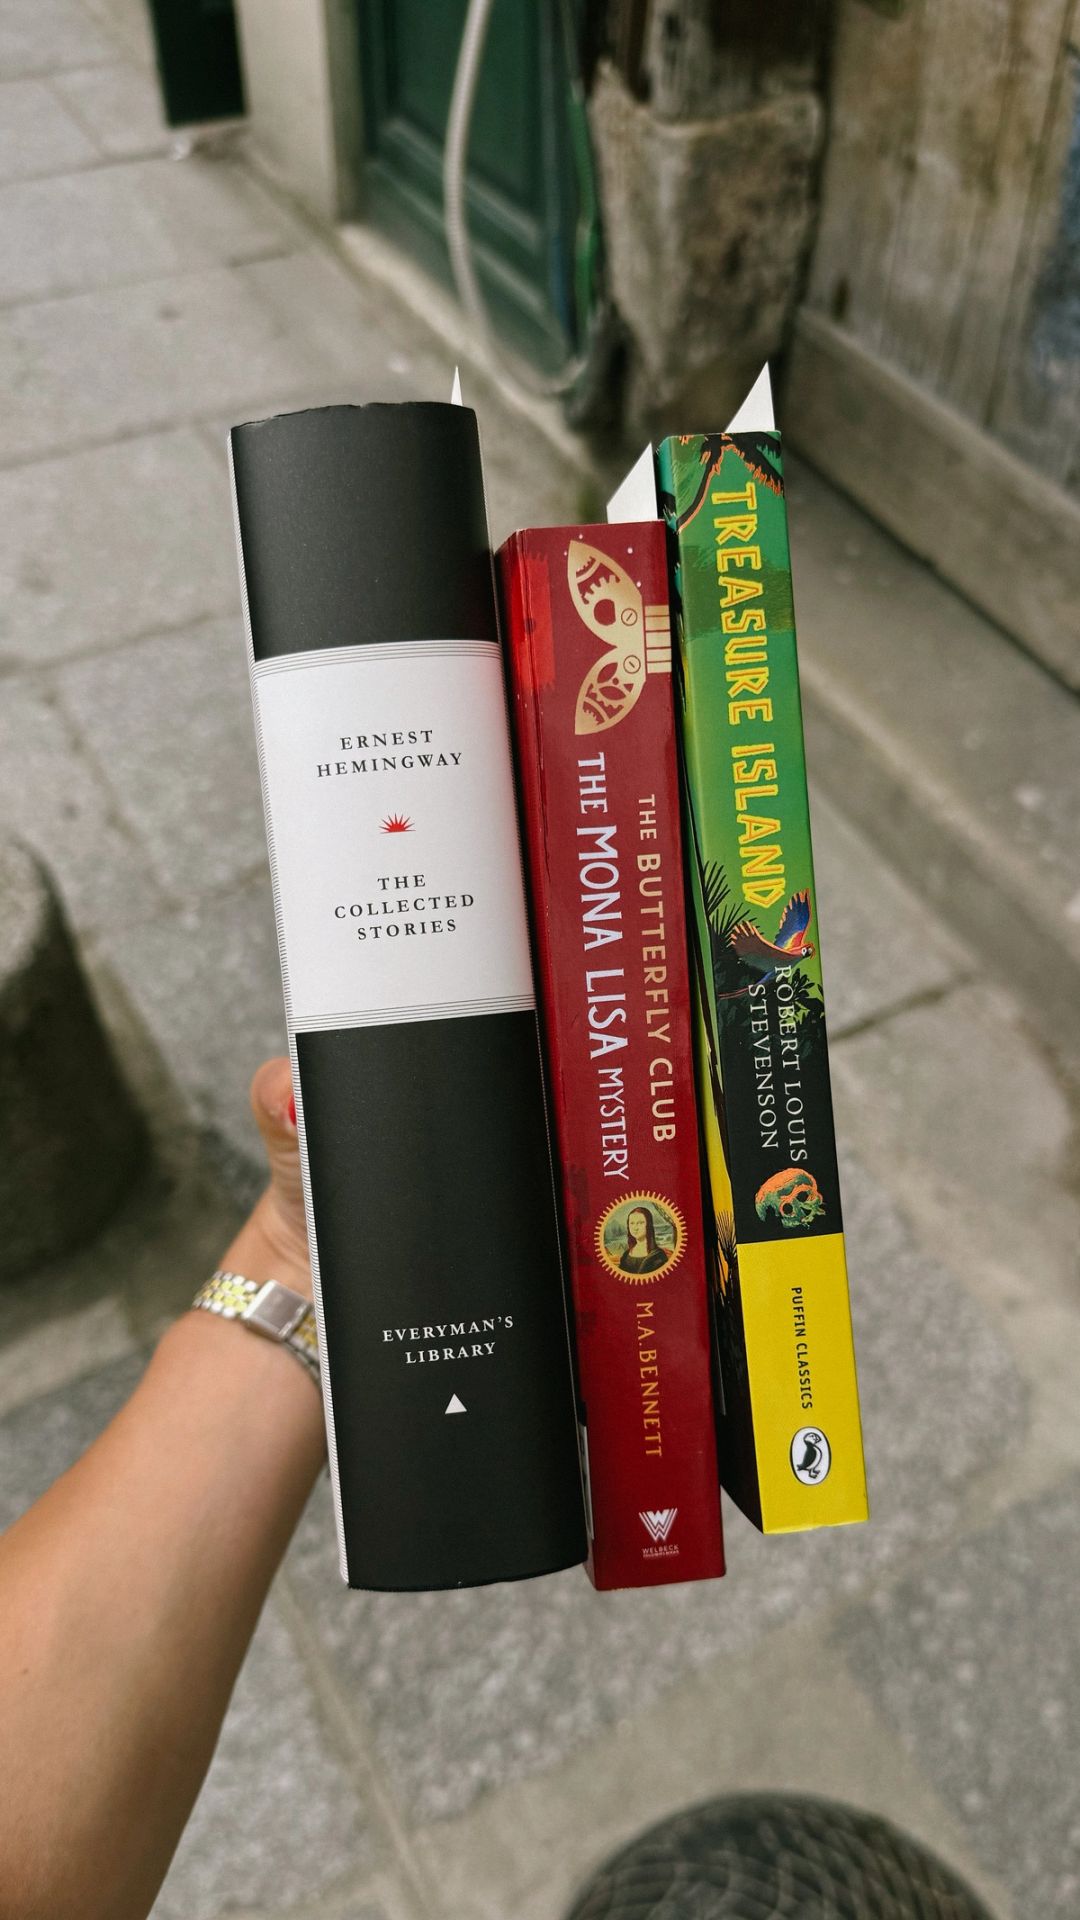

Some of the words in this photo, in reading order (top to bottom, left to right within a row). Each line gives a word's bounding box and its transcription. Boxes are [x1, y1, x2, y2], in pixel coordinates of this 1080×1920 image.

[711, 482, 773, 725] TREASURE
[317, 752, 463, 778] HEMINGWAY
[340, 730, 433, 750] ERNEST
[577, 751, 609, 815] THE
[638, 794, 657, 841] THE
[731, 742, 786, 907] ISLAND
[334, 894, 475, 919] COLLECTED
[377, 874, 426, 891] THE
[576, 825, 623, 952] MONA
[357, 919, 457, 941] STORIES
[637, 853, 672, 1043] BUTTERFLY
[585, 968, 629, 1060] LISA
[774, 964, 801, 1071] ROBERT
[649, 1057, 677, 1143] CLUB
[747, 983, 779, 1150] STEVENSON
[598, 1067, 630, 1180] MYSTERY
[784, 1079, 809, 1162] LOUIS
[382, 1315, 514, 1342] EVERYMAN'S
[791, 1286, 806, 1337] PUFFIN
[405, 1342, 496, 1364] LIBRARY
[796, 1342, 813, 1410] CLASSICS
